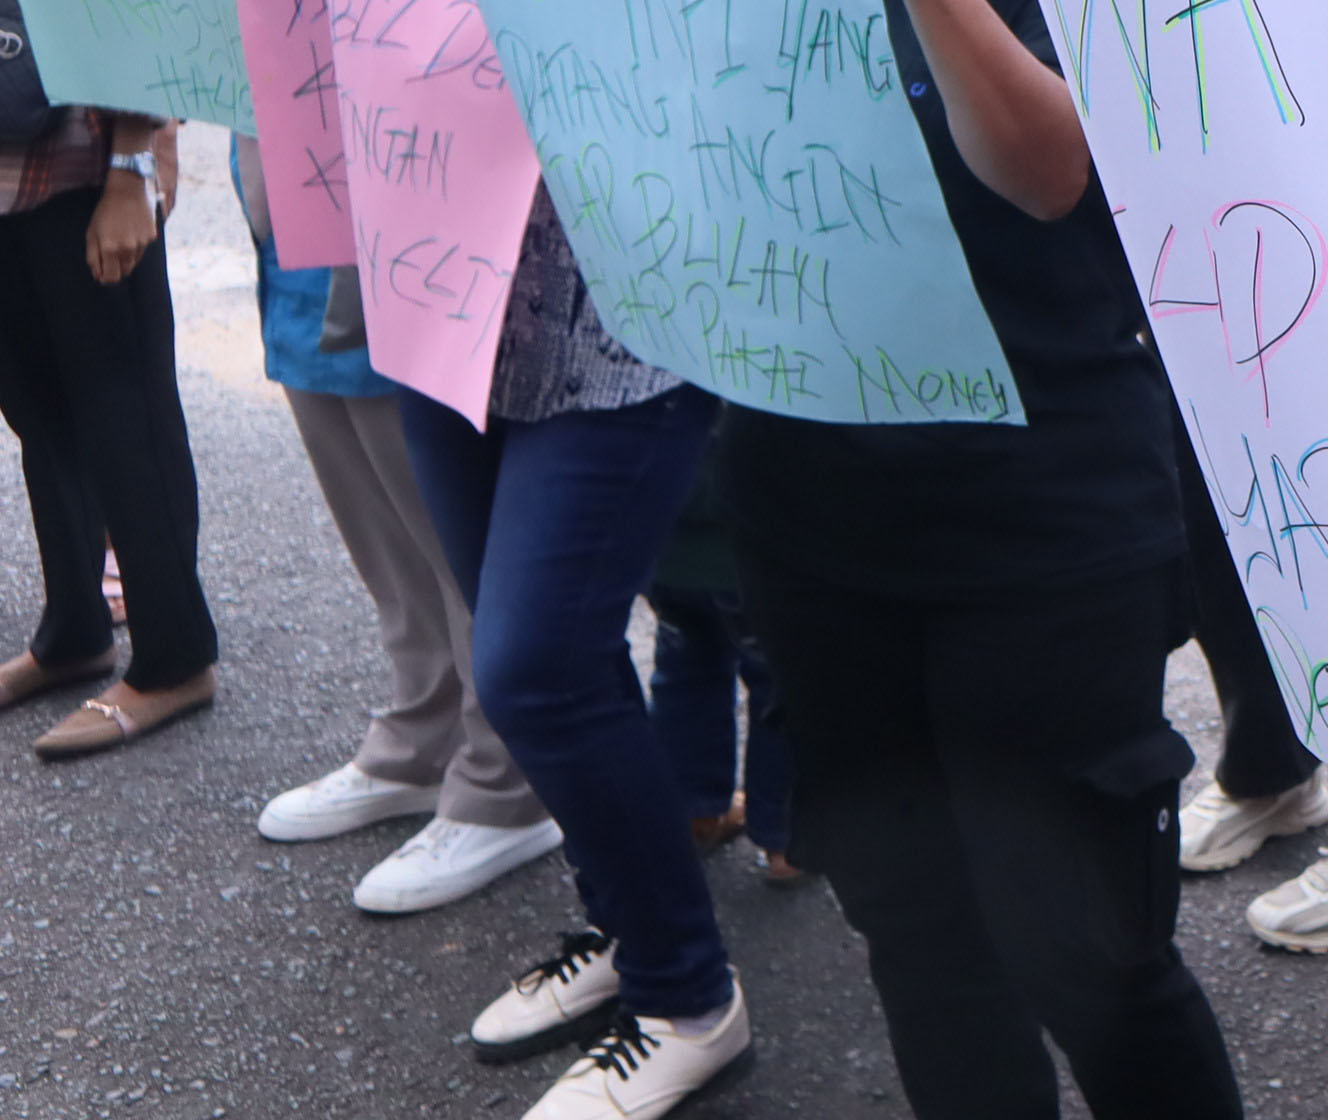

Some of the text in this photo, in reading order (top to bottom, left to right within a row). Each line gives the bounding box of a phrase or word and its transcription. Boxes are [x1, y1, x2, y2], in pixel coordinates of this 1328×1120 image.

[688, 92, 903, 248] ANGIN
[685, 282, 825, 406] PAKAI
[842, 344, 1010, 424] MONEY
